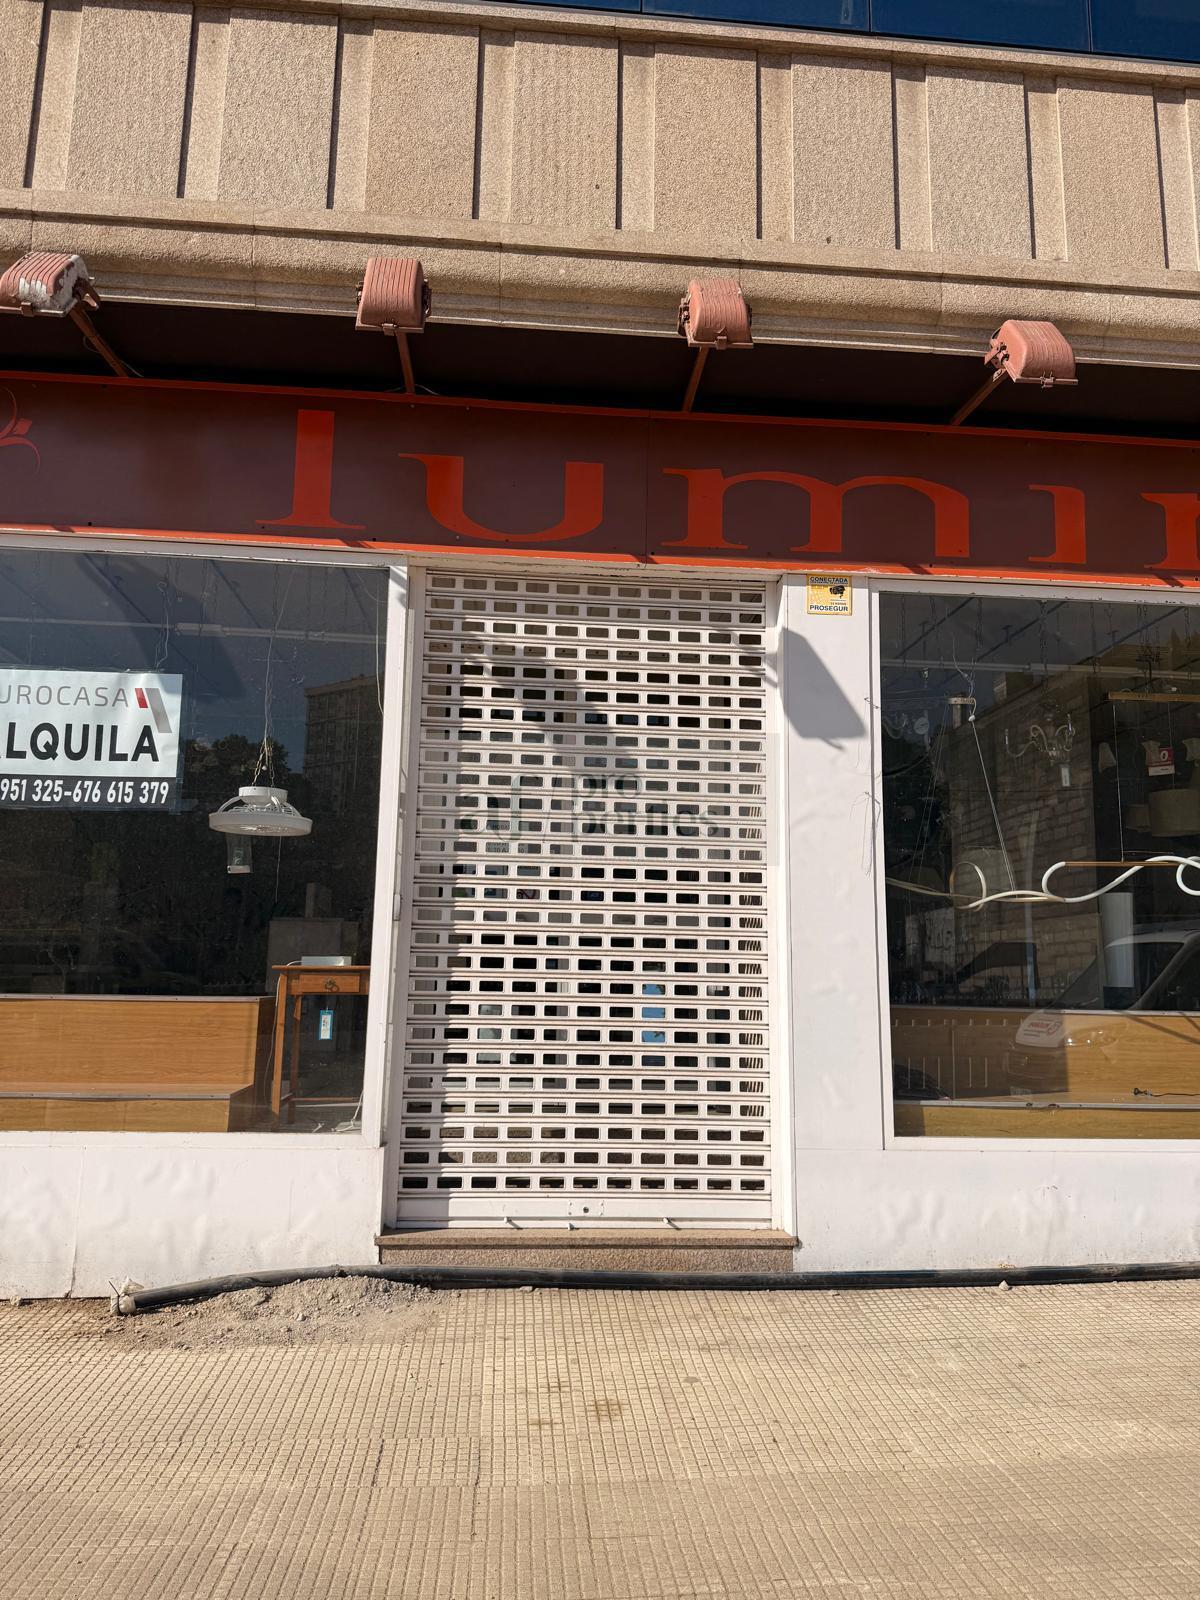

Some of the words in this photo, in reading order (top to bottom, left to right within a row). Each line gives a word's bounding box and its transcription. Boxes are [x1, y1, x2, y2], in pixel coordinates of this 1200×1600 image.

[0, 722, 159, 762] LQUILA
[0, 778, 27, 801] 951
[32, 779, 101, 803] 325-676
[107, 781, 134, 803] 615
[139, 781, 169, 804] 379
